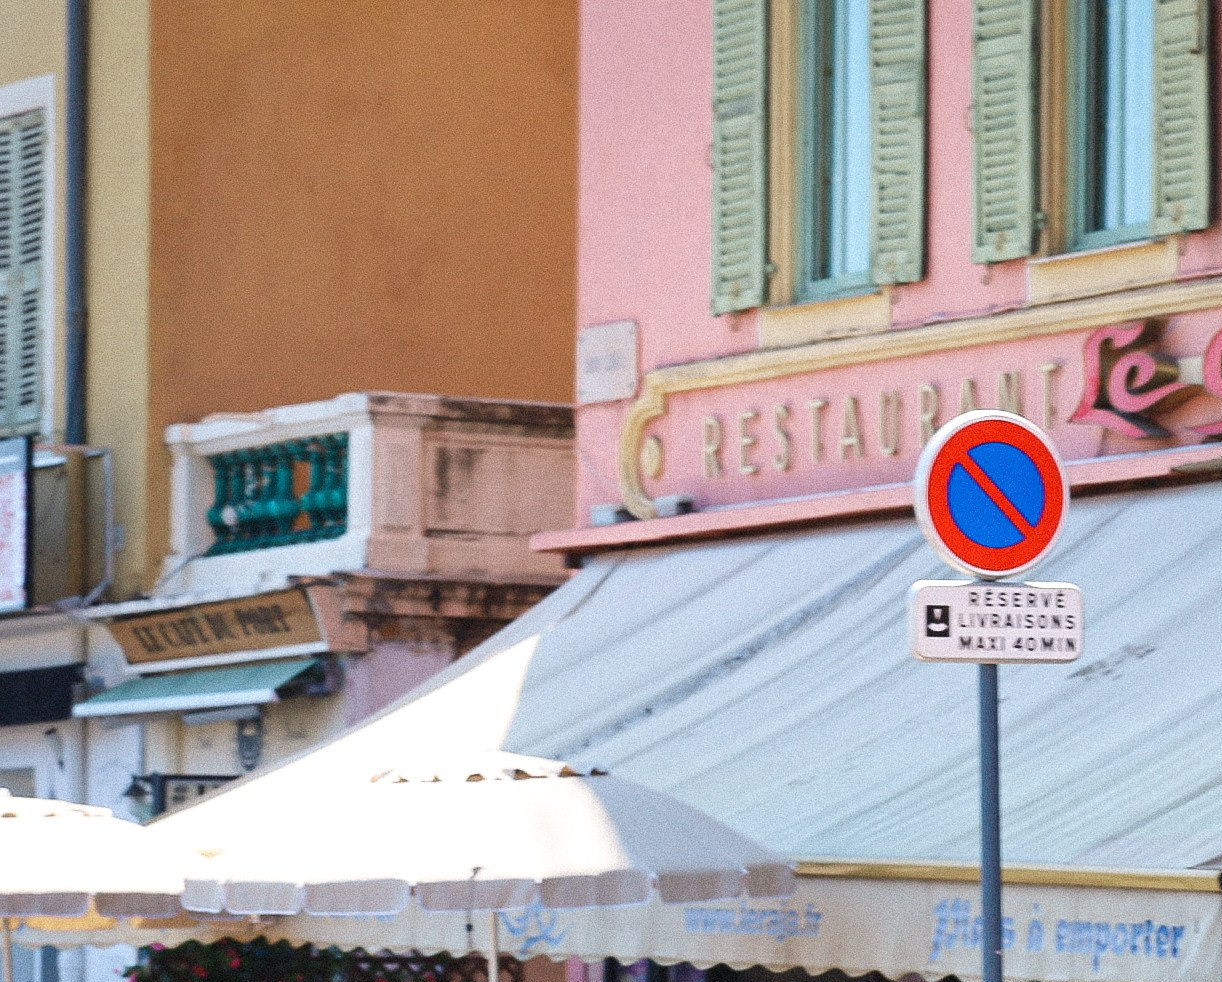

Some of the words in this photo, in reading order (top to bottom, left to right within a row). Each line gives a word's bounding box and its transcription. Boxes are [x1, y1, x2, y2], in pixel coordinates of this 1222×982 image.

[1068, 321, 1191, 438] Le
[704, 362, 1062, 480] RESTAURANT
[957, 613, 1077, 630] LIVRAISONS
[959, 635, 1007, 652] MAXI
[1054, 918, 1187, 972] emporter
